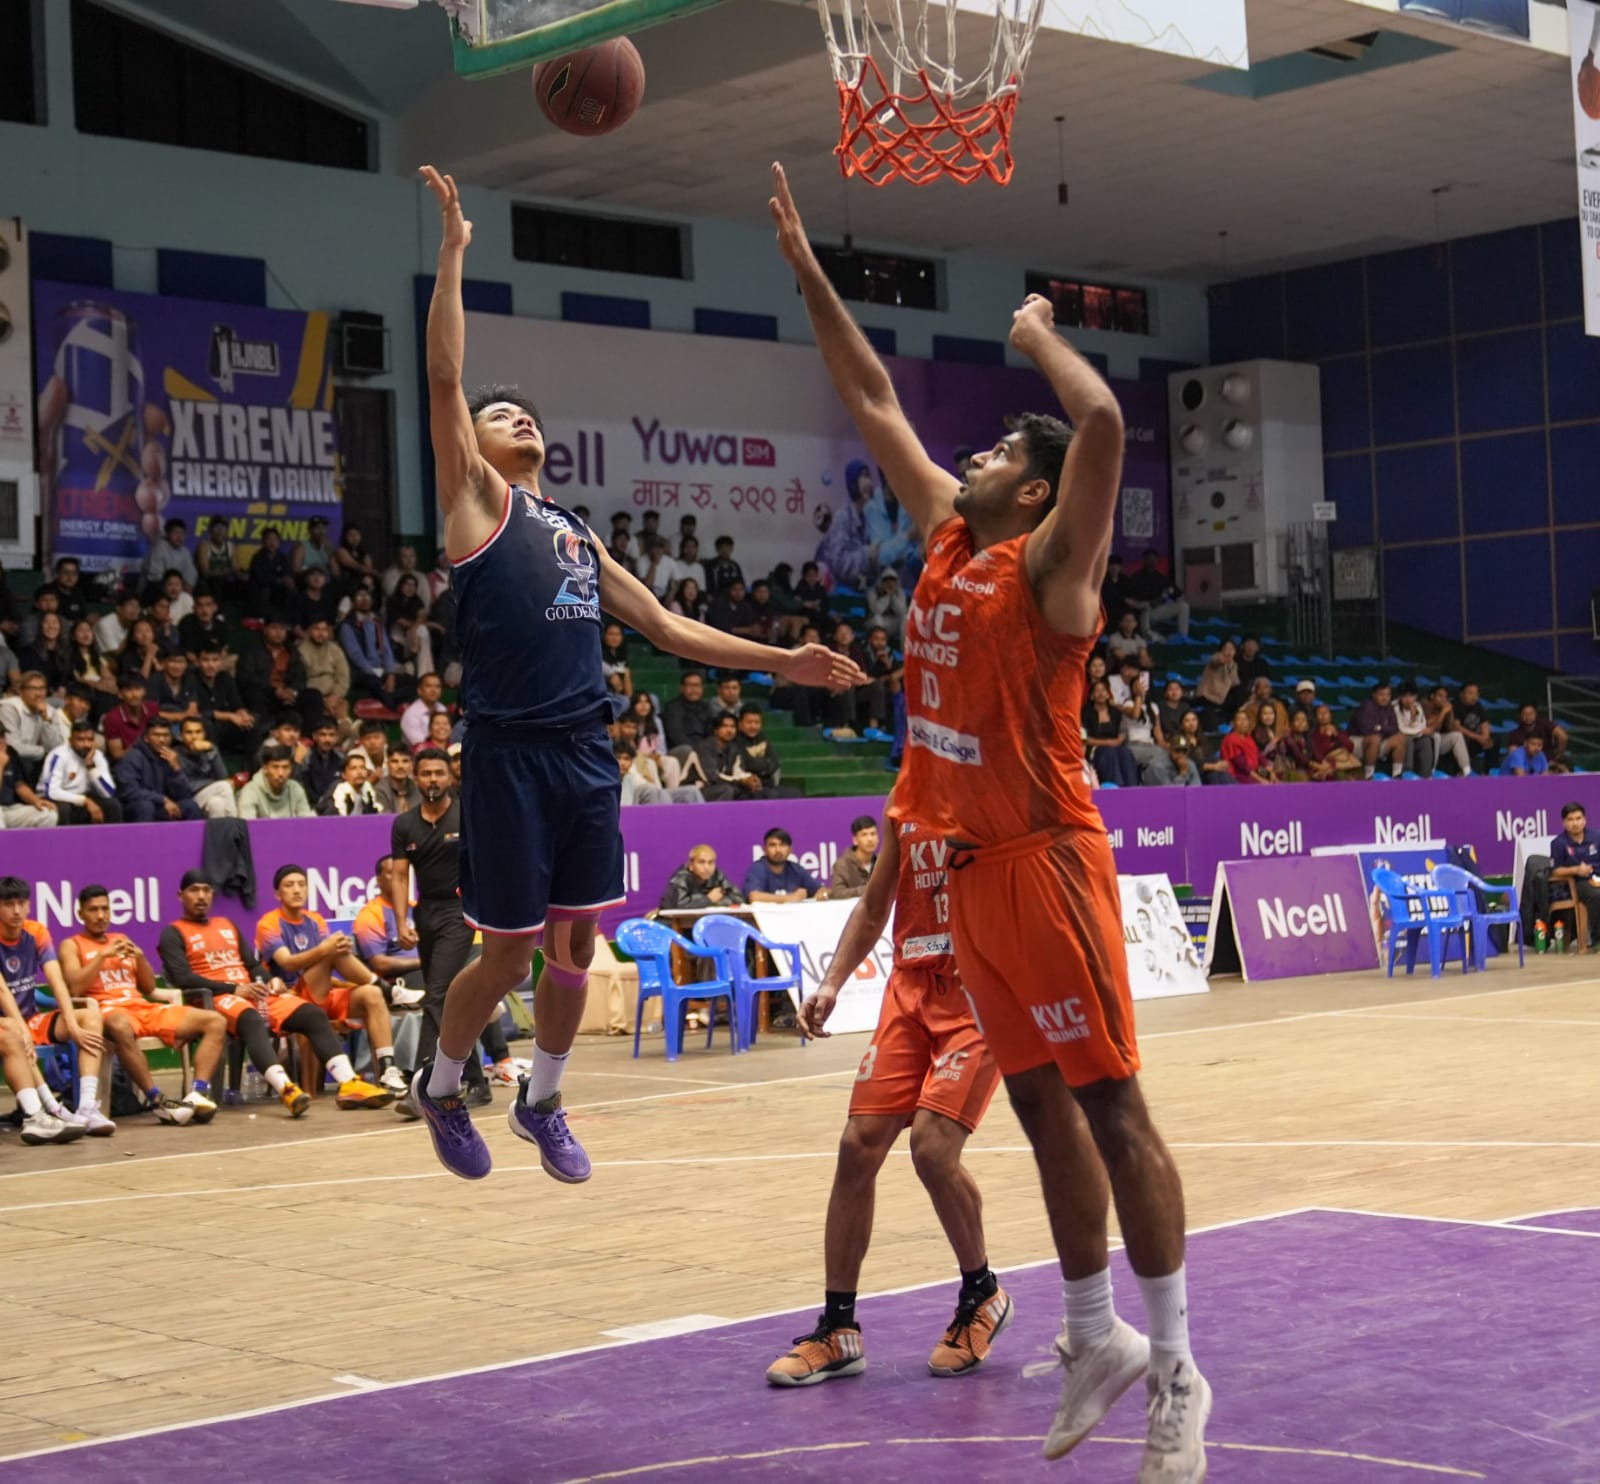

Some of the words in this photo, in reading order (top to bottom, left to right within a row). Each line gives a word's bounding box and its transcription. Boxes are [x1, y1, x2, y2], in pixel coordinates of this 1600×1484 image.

[169, 399, 335, 467] XTREME
[632, 416, 737, 465] Yuwa
[744, 442, 770, 460] SIM
[171, 461, 262, 499] ENERGY
[269, 466, 337, 503] DRINK
[632, 480, 680, 508] मात्र
[690, 483, 718, 510] रु.
[195, 516, 247, 539] FN
[951, 573, 996, 594] Ncell
[1137, 826, 1174, 847] Ncell
[1240, 821, 1303, 857] Ncell
[1375, 814, 1431, 845] Ncell
[1496, 809, 1548, 842] Ncell
[36, 877, 160, 928] Nell
[933, 893, 949, 923] 13
[1257, 893, 1347, 940] Ncell
[1030, 997, 1086, 1029] KVC
